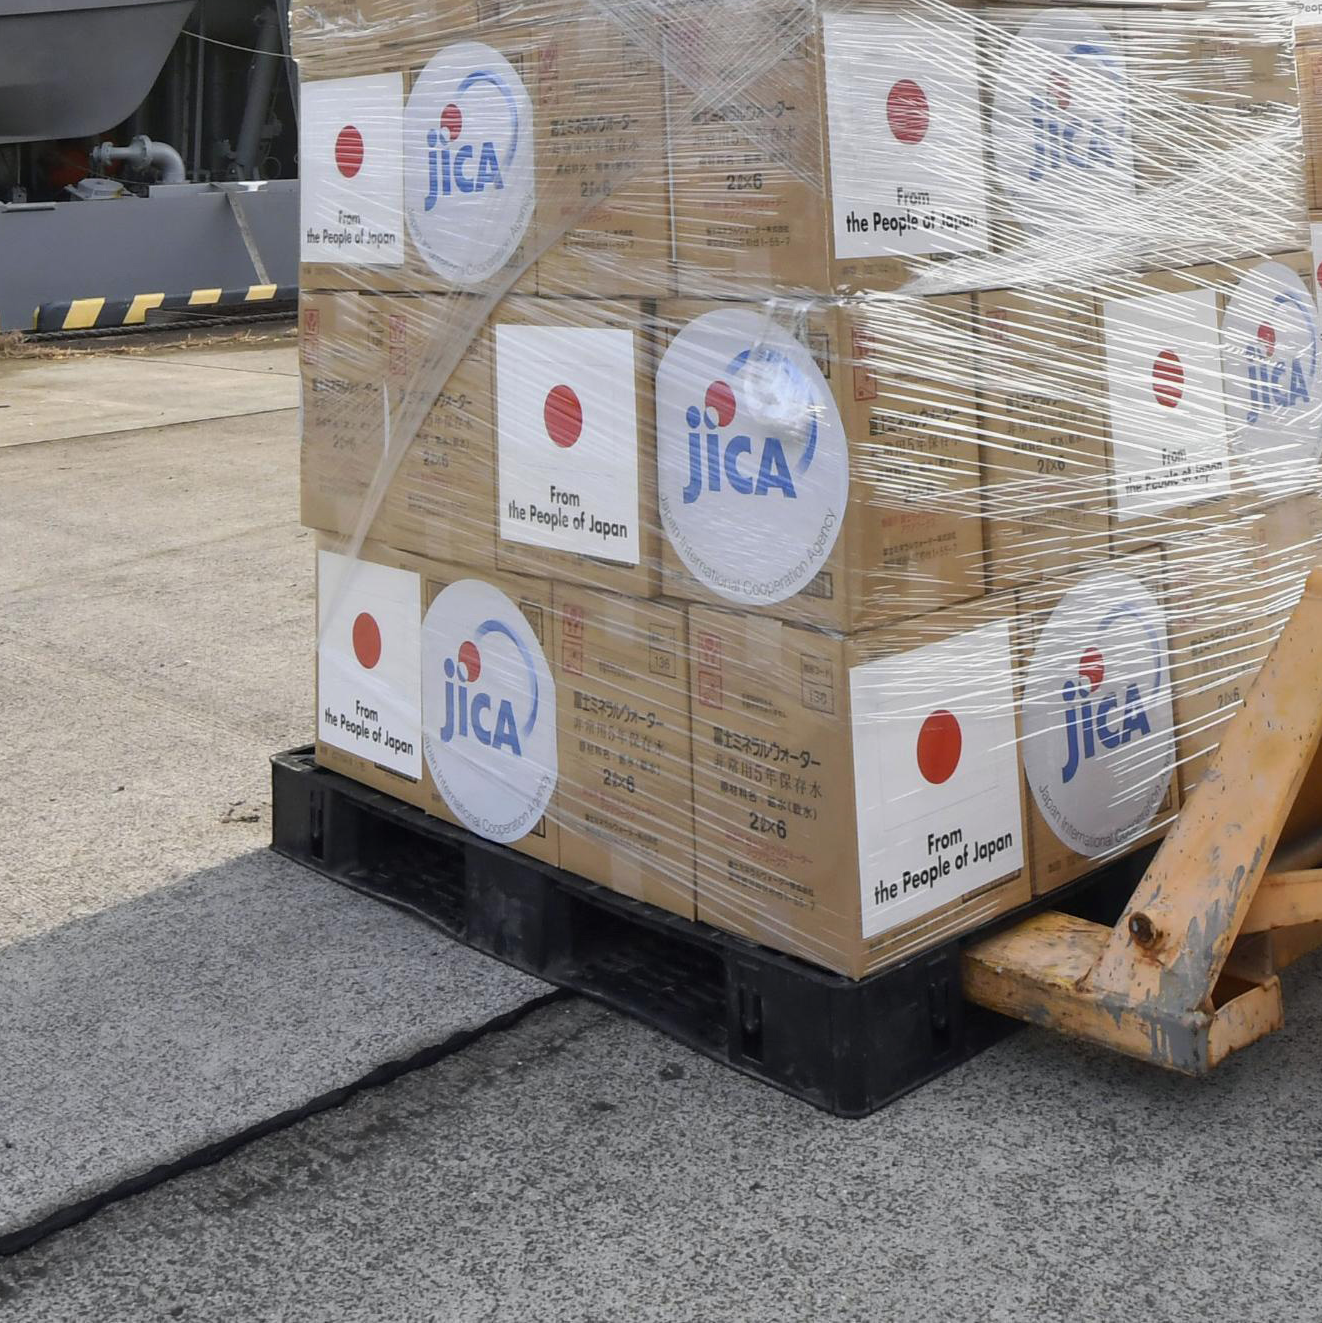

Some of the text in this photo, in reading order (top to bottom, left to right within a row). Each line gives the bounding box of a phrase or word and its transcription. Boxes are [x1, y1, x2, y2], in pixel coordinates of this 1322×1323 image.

[897, 187, 930, 206] From
[338, 210, 360, 225] From
[846, 209, 978, 236] the People of Japan
[306, 229, 396, 249] the People of Japan
[550, 485, 581, 508] From
[508, 500, 628, 540] the People of Japan
[742, 562, 809, 597] Cooperation
[807, 507, 839, 566] Agency
[355, 700, 379, 722] From
[324, 707, 414, 757] the People of Japan
[712, 725, 822, 770] 富士ミネラルウォーター
[1038, 784, 1062, 825] Japan
[927, 825, 963, 856] From
[874, 831, 1013, 906] the People of Japan
